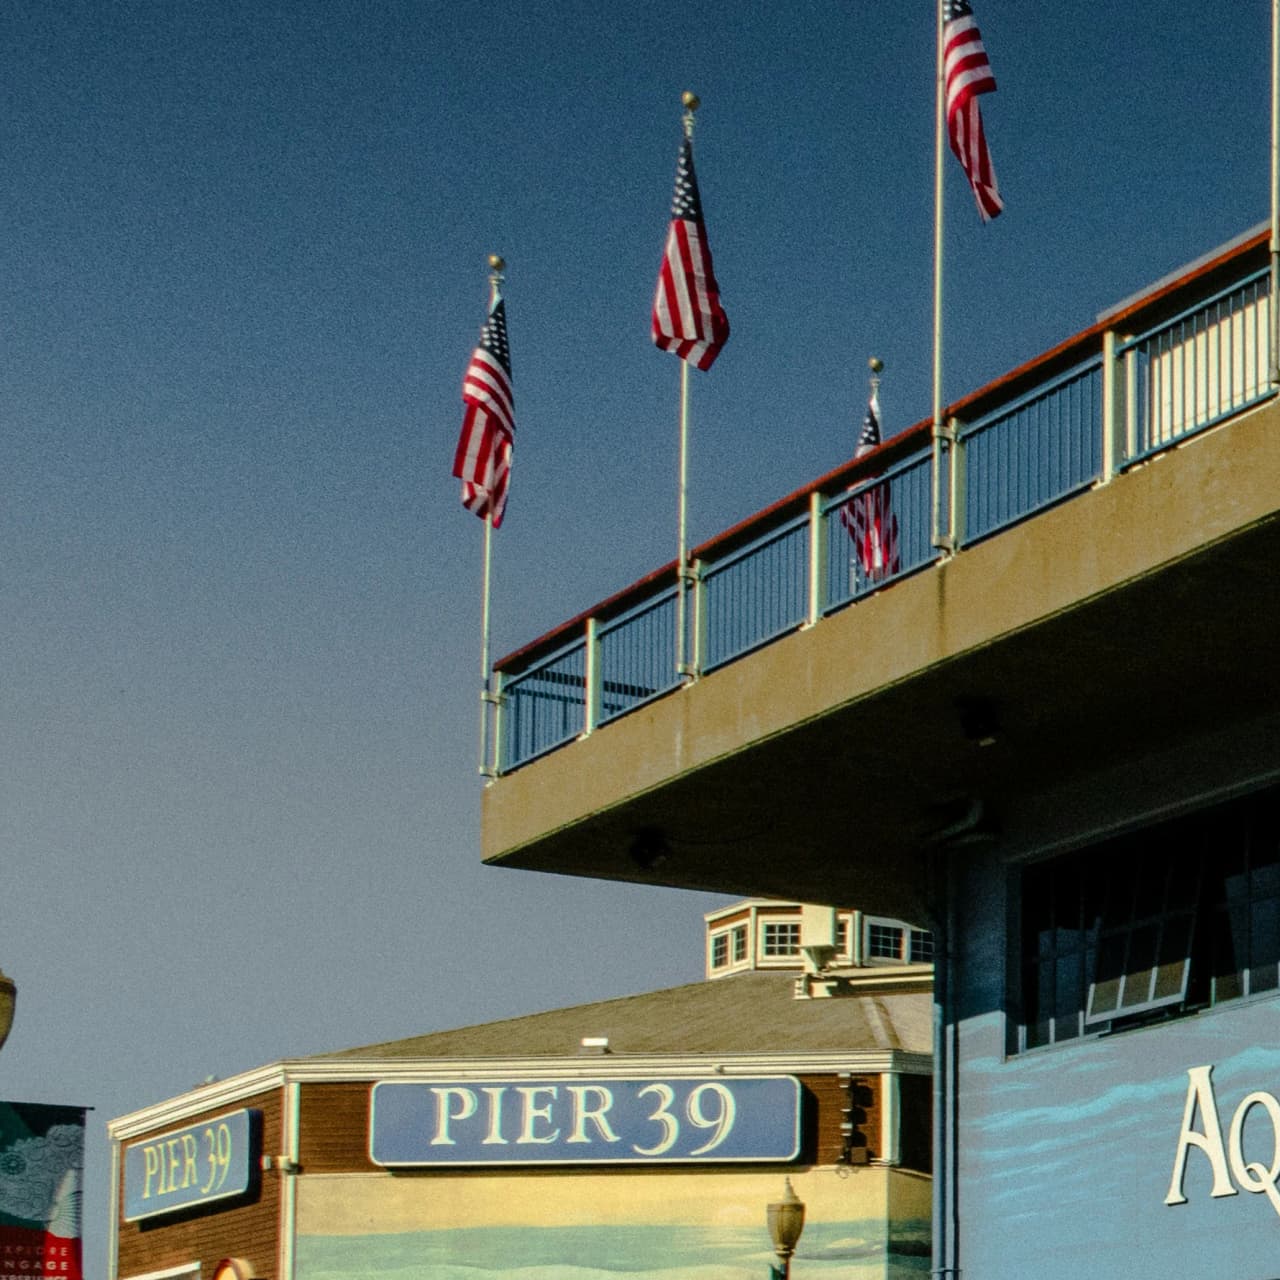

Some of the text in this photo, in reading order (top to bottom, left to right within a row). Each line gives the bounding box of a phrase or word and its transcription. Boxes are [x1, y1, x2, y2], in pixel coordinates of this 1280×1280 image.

[429, 1082, 736, 1156] PIER 39
[143, 1123, 231, 1199] PIER 39
[4, 1260, 69, 1270] NGAGE
[5, 1246, 69, 1257] XPLORE
